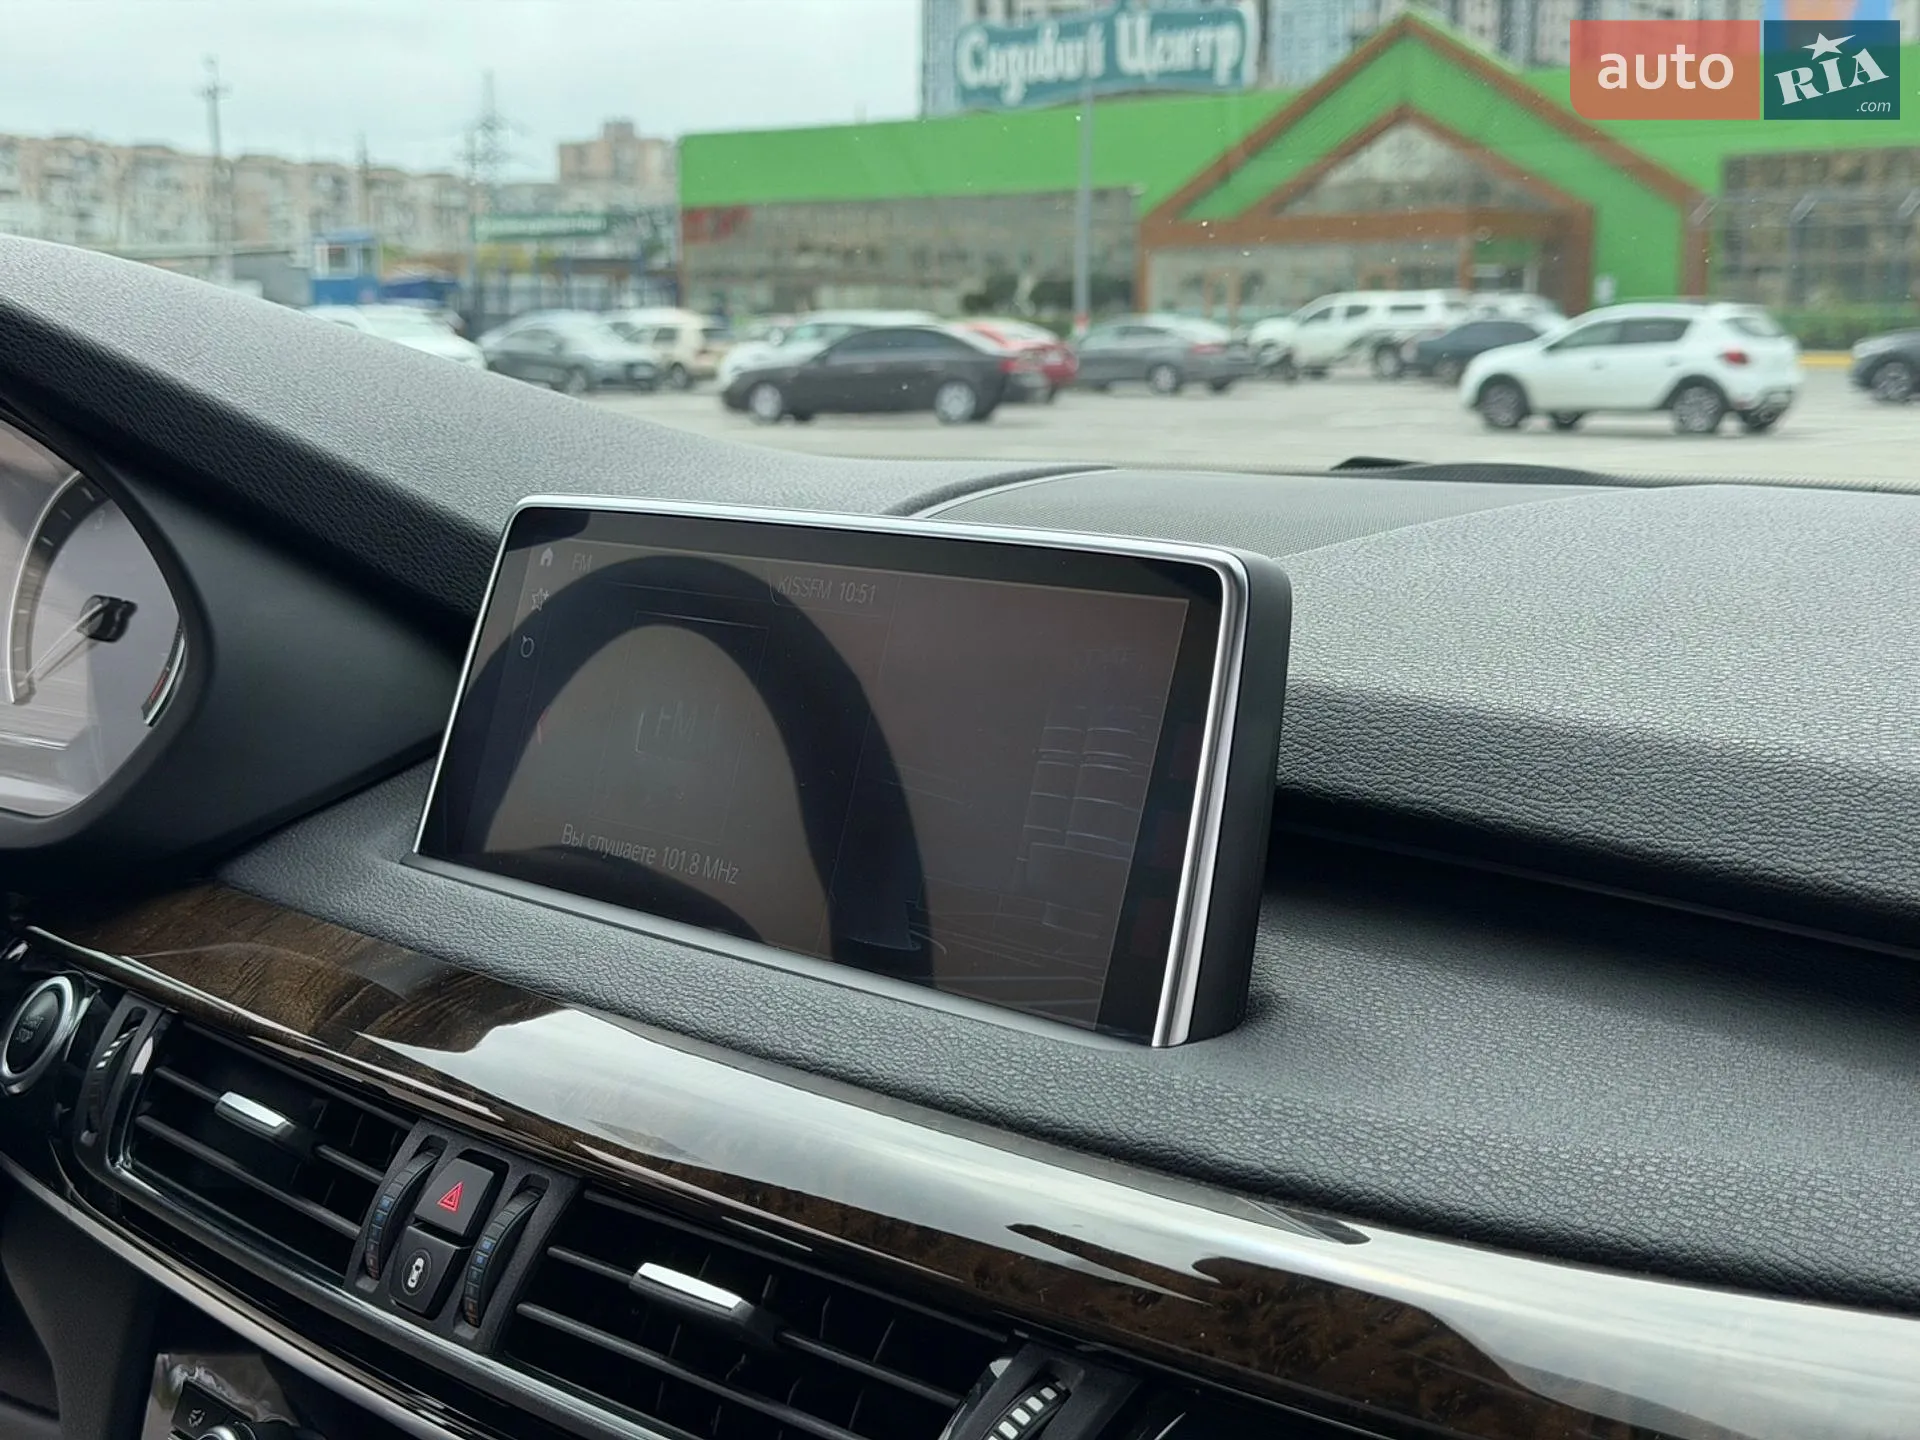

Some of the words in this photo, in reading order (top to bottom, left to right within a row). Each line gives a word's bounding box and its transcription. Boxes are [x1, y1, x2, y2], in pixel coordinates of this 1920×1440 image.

[571, 552, 593, 571] FM
[839, 581, 876, 604] 10:51
[561, 823, 584, 847] Вы
[587, 833, 658, 865] слушаете
[662, 846, 701, 875] 101.8
[703, 855, 740, 885] MHz
